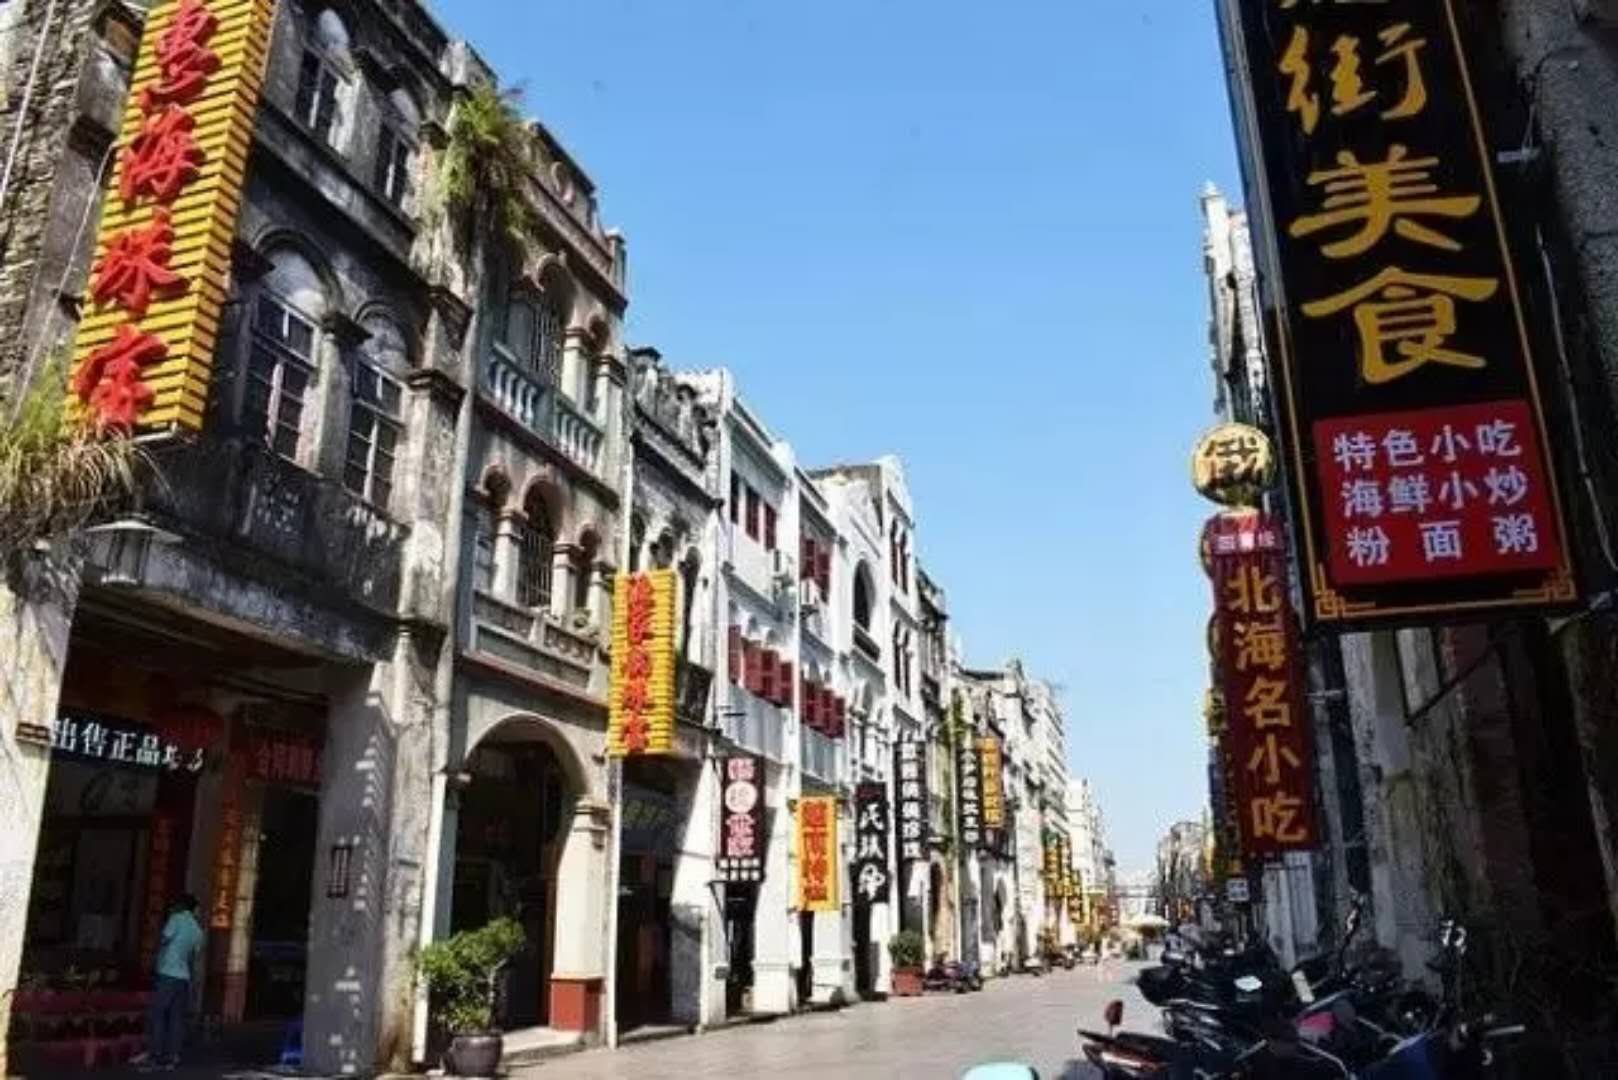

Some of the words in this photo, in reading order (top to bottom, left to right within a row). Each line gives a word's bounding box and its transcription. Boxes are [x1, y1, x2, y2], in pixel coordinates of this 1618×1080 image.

[1279, 0, 1499, 385] 街美食
[1333, 420, 1523, 471] 特色小吃
[1341, 465, 1529, 518] 海鲜小炒
[1346, 527, 1391, 567] 粉
[1419, 518, 1463, 561] 面
[1493, 513, 1539, 554] 粥
[1222, 564, 1307, 844] 北海名小吃
